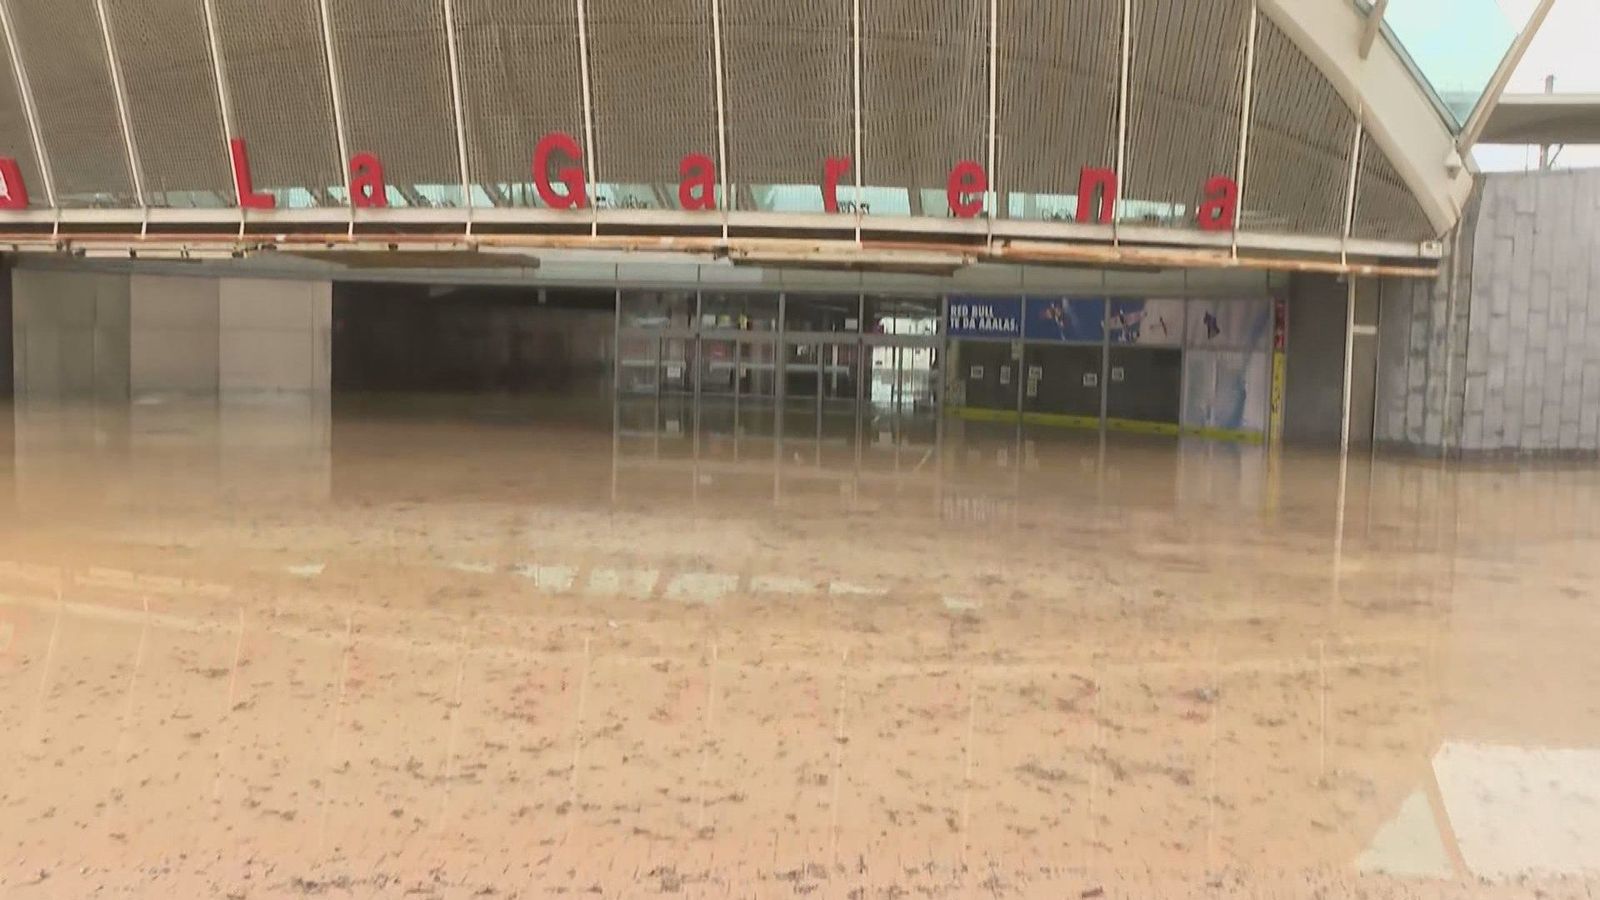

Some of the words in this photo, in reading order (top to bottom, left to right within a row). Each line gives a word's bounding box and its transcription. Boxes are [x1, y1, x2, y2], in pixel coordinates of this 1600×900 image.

[230, 138, 388, 209] La
[532, 132, 1238, 231] Garena
[950, 304, 968, 317] RED
[972, 305, 994, 318] BULL
